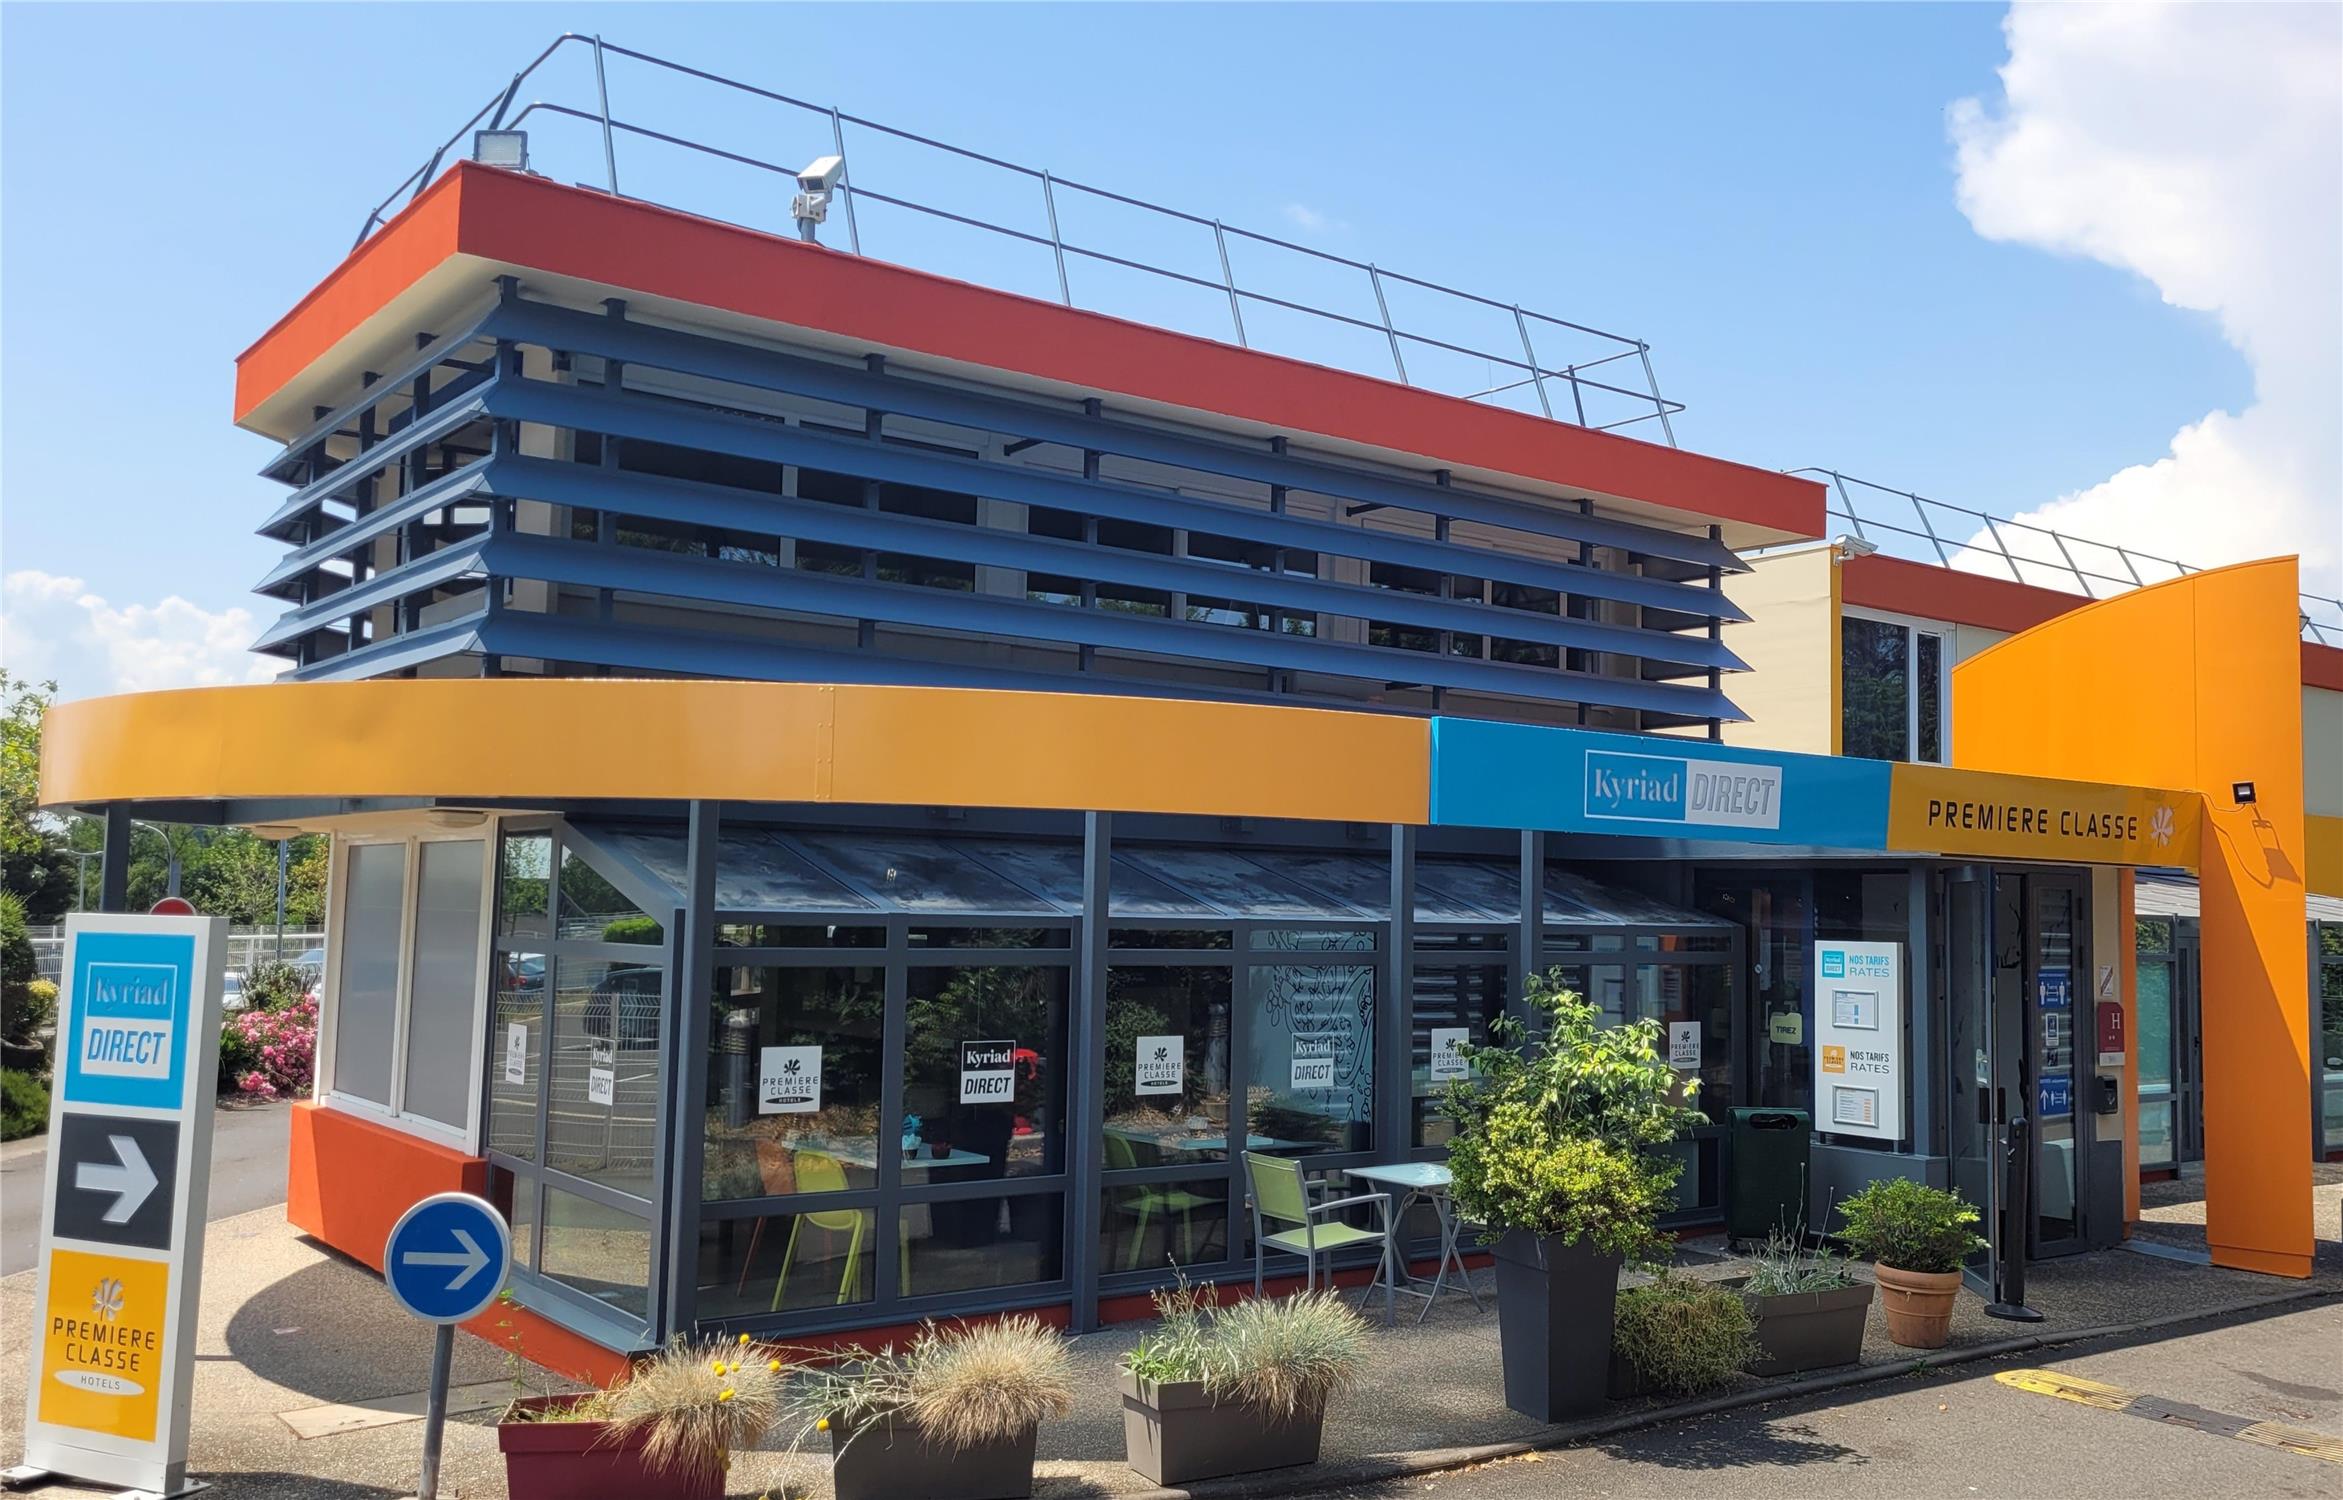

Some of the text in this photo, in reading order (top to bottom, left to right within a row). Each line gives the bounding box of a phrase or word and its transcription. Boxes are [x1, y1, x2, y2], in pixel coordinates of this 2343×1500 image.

[1594, 768, 1776, 815] Kyriad DIRECT
[1928, 800, 2138, 840] PREMIERE CLASSE
[1849, 955, 1864, 964] NOS
[1866, 956, 1889, 966] TARIFS
[1849, 968, 1890, 977] RATES
[95, 977, 168, 1011] Kyriad
[2112, 1013, 2120, 1029] H
[1775, 1025, 1797, 1035] TIREZ
[87, 1028, 167, 1065] DIRECT
[1296, 1040, 1330, 1056] Kyriad
[592, 1048, 613, 1066] Kyriad
[967, 1049, 1011, 1068] Kyriad
[1850, 1051, 1864, 1061] NOS
[1866, 1052, 1889, 1063] TARIFS
[1138, 1063, 1182, 1071] PREMIERE
[1144, 1071, 1176, 1079] CLASSE
[1295, 1065, 1331, 1080] DIRECT
[1850, 1063, 1890, 1074] RATES
[591, 1076, 612, 1095] DIRECT
[762, 1076, 819, 1086] PREMIERE
[964, 1077, 1011, 1094] DIRECT
[770, 1086, 811, 1095] CLASSE
[53, 1317, 155, 1350] PREMIERE
[66, 1343, 140, 1372] CLASSE
[80, 1375, 121, 1390] HOTELS
